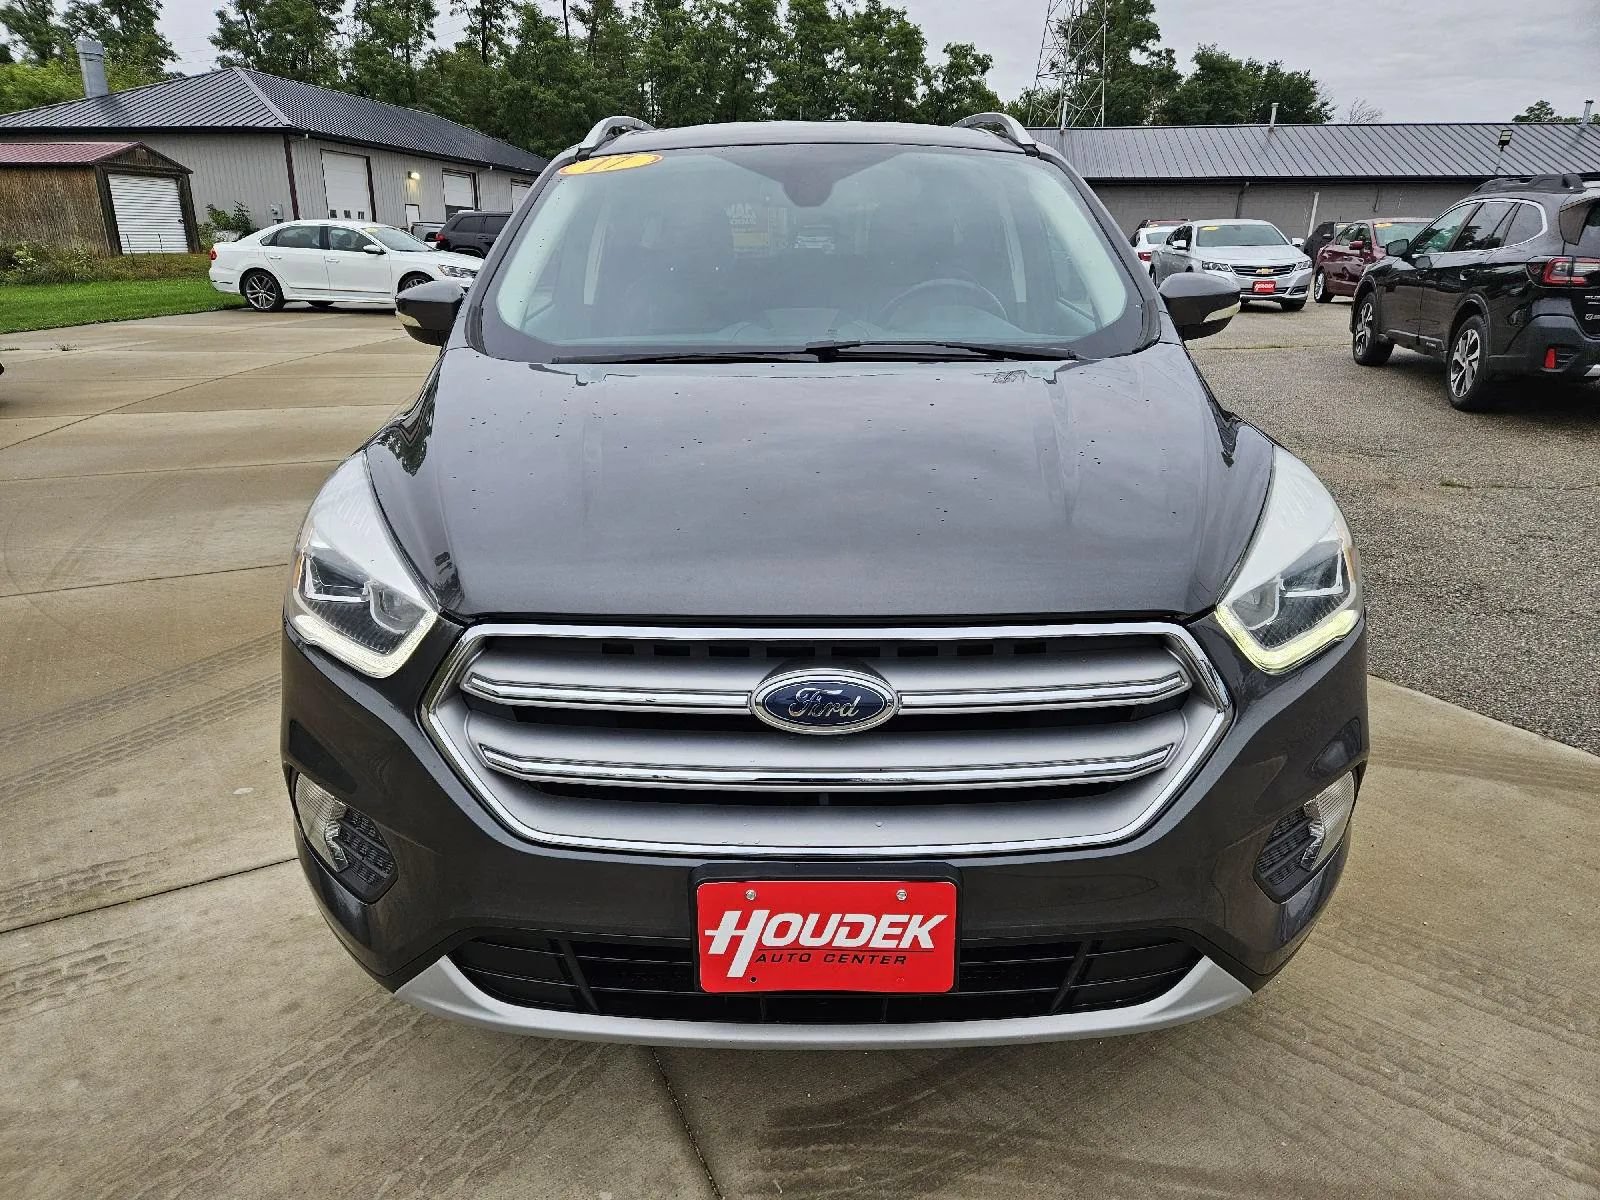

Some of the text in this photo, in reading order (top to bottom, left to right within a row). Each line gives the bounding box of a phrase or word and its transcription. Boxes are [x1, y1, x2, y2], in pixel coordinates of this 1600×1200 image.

[788, 687, 862, 717] Ford
[704, 909, 948, 978] HOUDEK
[755, 952, 907, 965] AUTO CENTER
